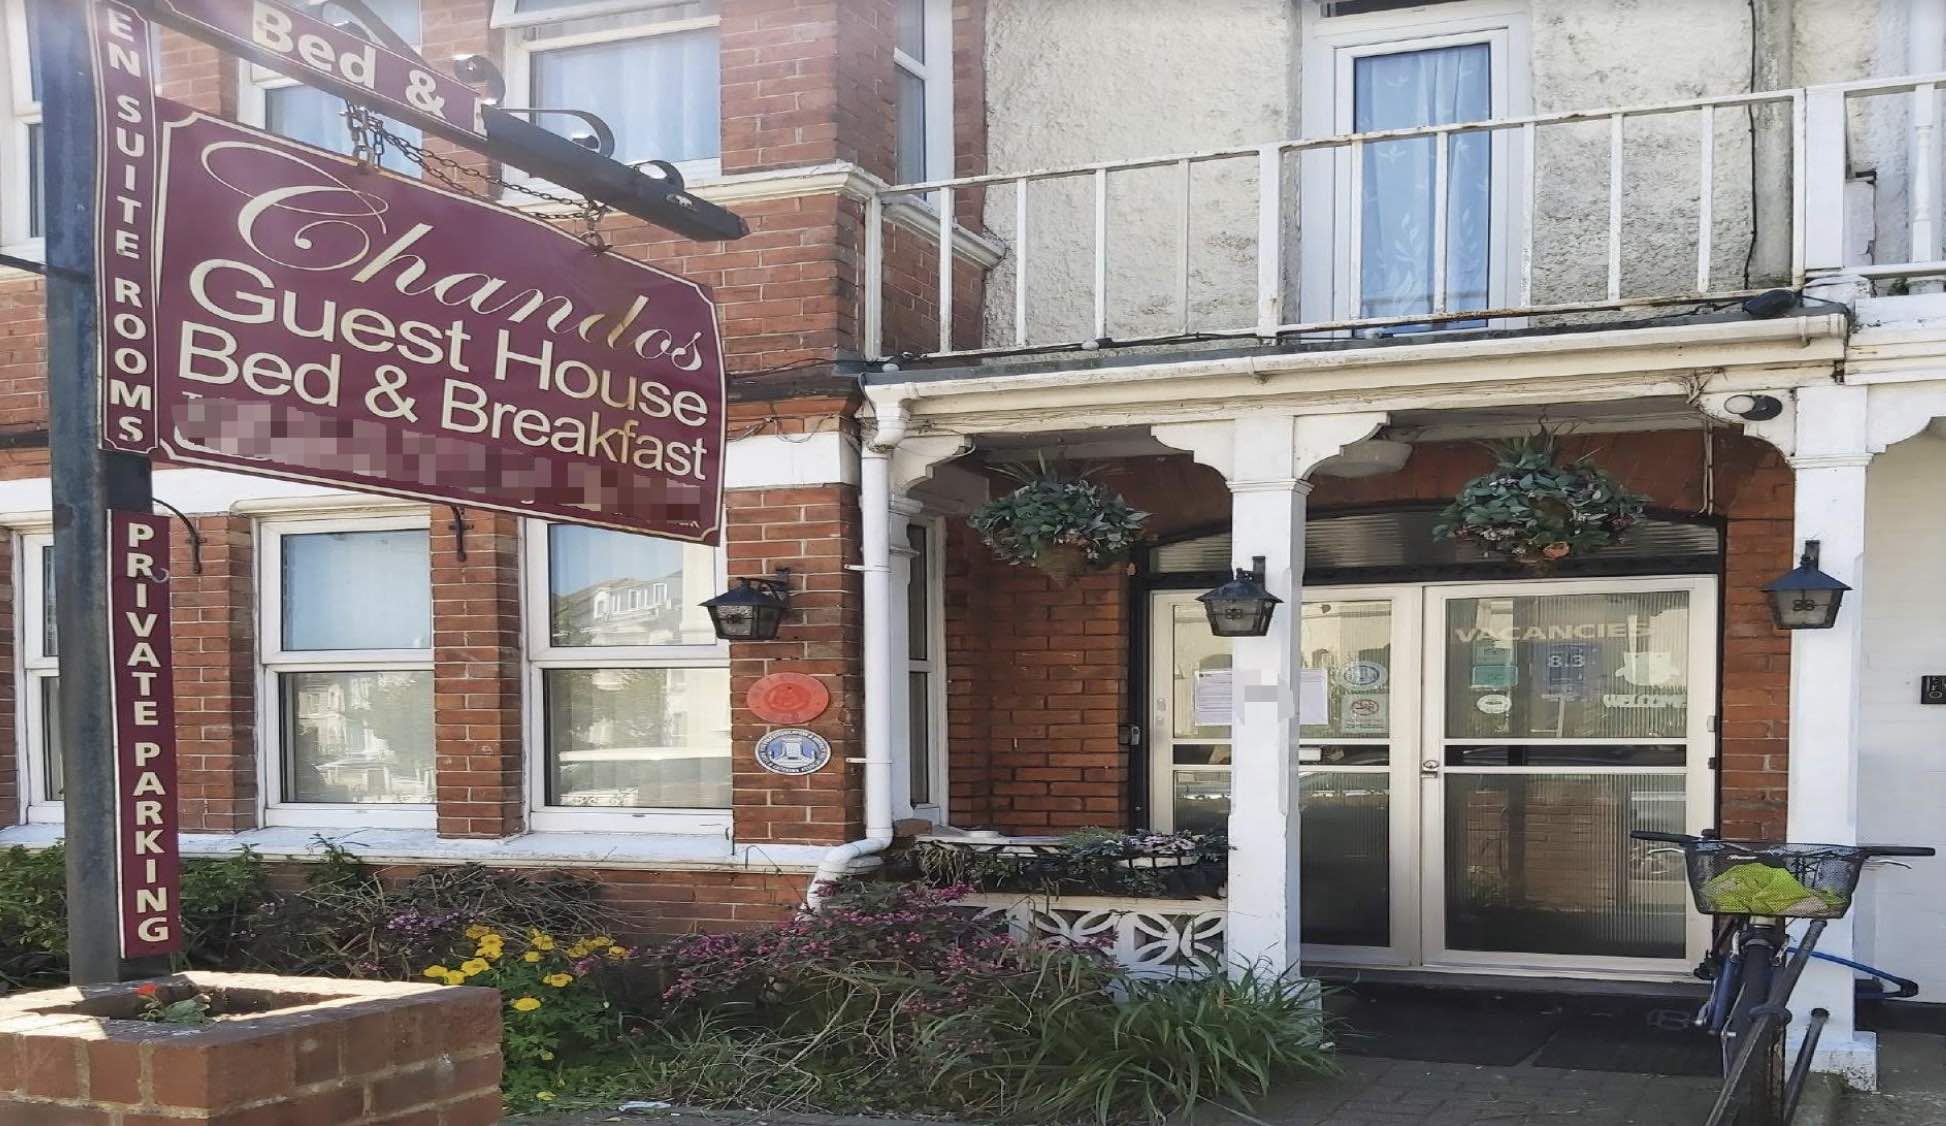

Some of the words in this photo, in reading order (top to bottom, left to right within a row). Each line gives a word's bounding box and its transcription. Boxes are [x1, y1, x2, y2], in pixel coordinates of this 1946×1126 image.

[107, 8, 142, 78] EN
[252, 1, 377, 89] Bed
[405, 69, 448, 121] &
[115, 94, 146, 260] SUITE
[201, 141, 702, 371] Chandos
[110, 277, 152, 442] ROOMS
[178, 320, 342, 408] Bed
[364, 364, 420, 422] &
[441, 377, 708, 481] Breakfast
[189, 258, 471, 373] Guest
[494, 328, 709, 427] House
[126, 522, 161, 726] PRIVATE
[132, 742, 169, 943] PARKING
